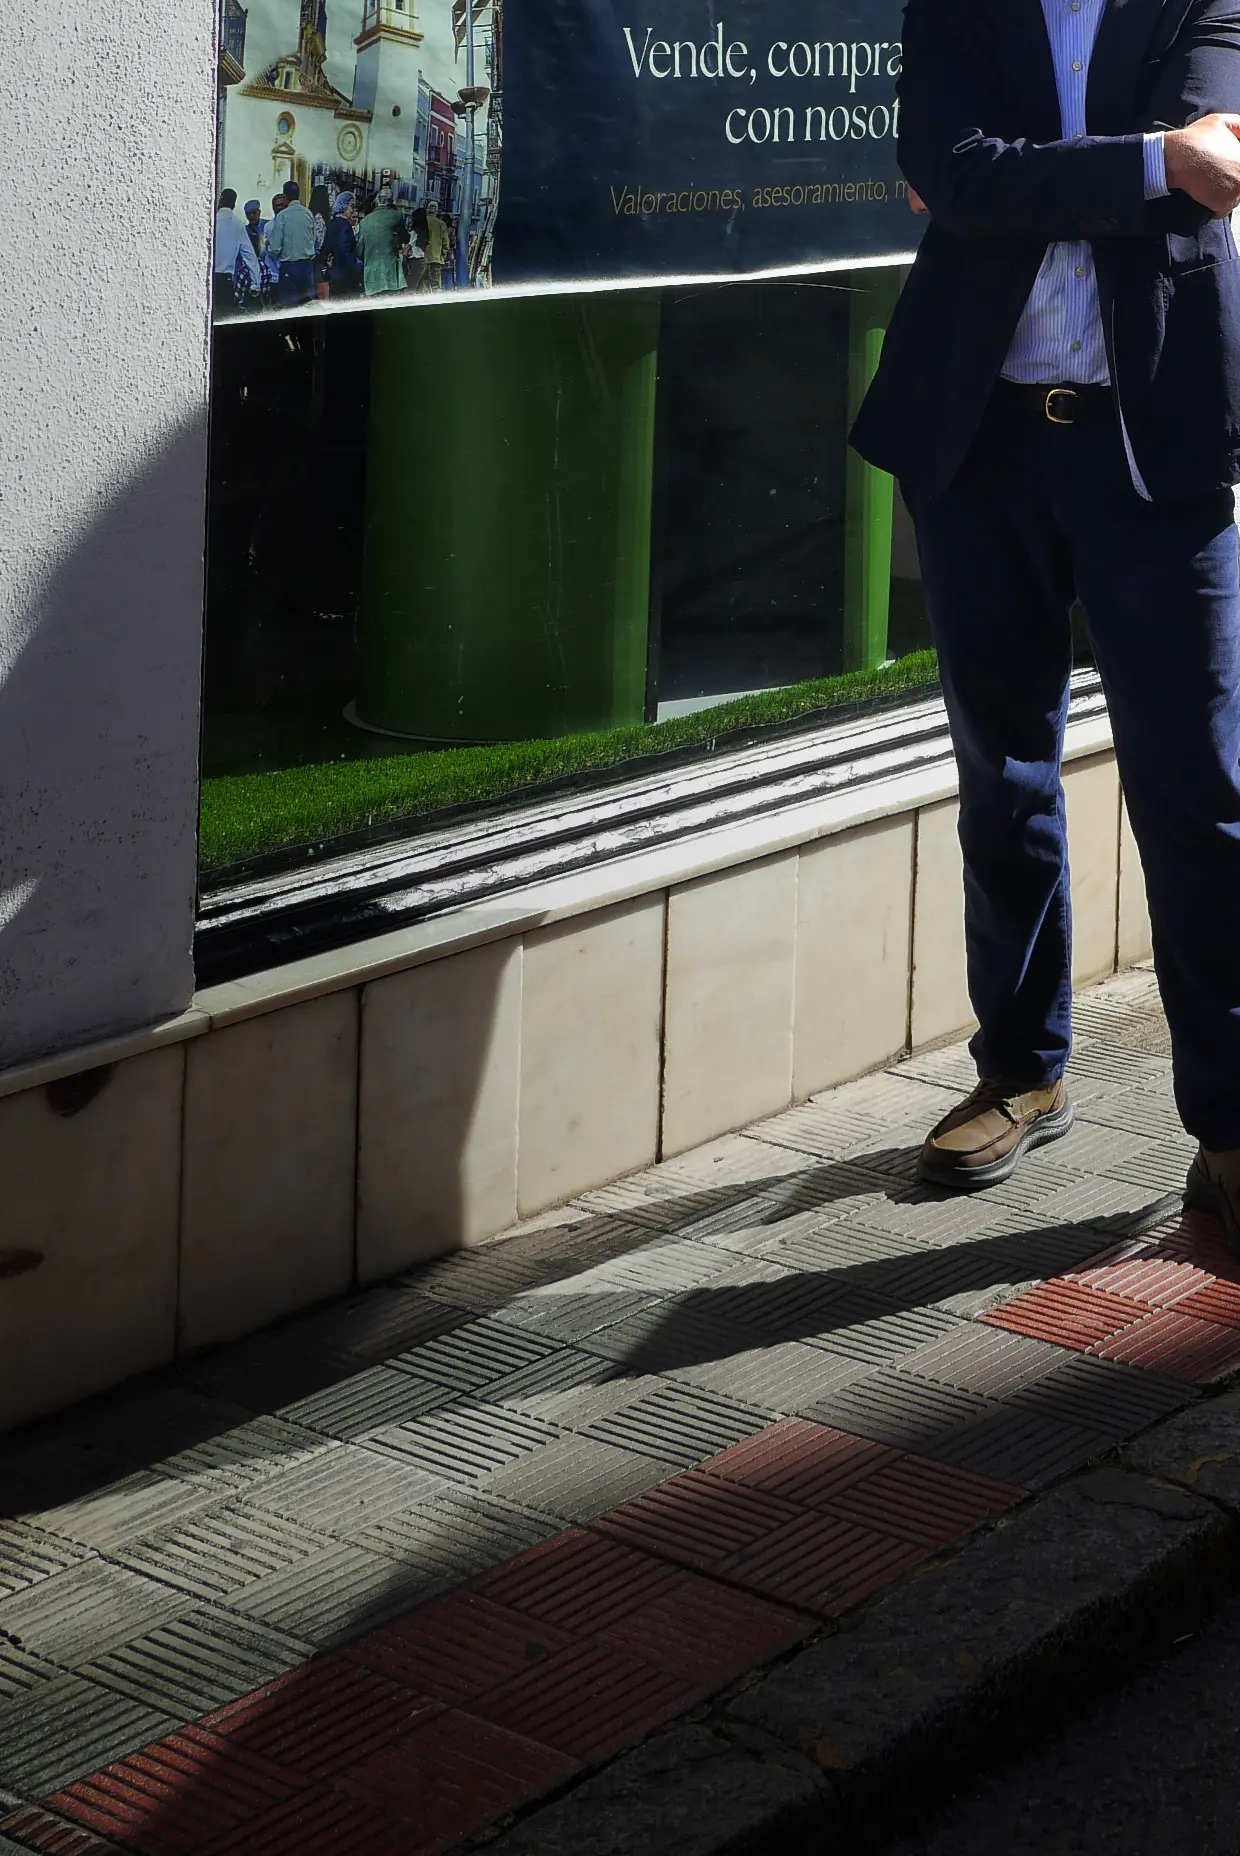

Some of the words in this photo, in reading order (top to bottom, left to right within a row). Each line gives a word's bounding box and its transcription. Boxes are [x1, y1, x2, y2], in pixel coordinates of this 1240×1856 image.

[622, 21, 758, 85] Vende,
[725, 106, 795, 144] con
[804, 98, 901, 142] nosot
[610, 184, 745, 215] Valoraciones,
[752, 178, 888, 208] asesoramiento,
